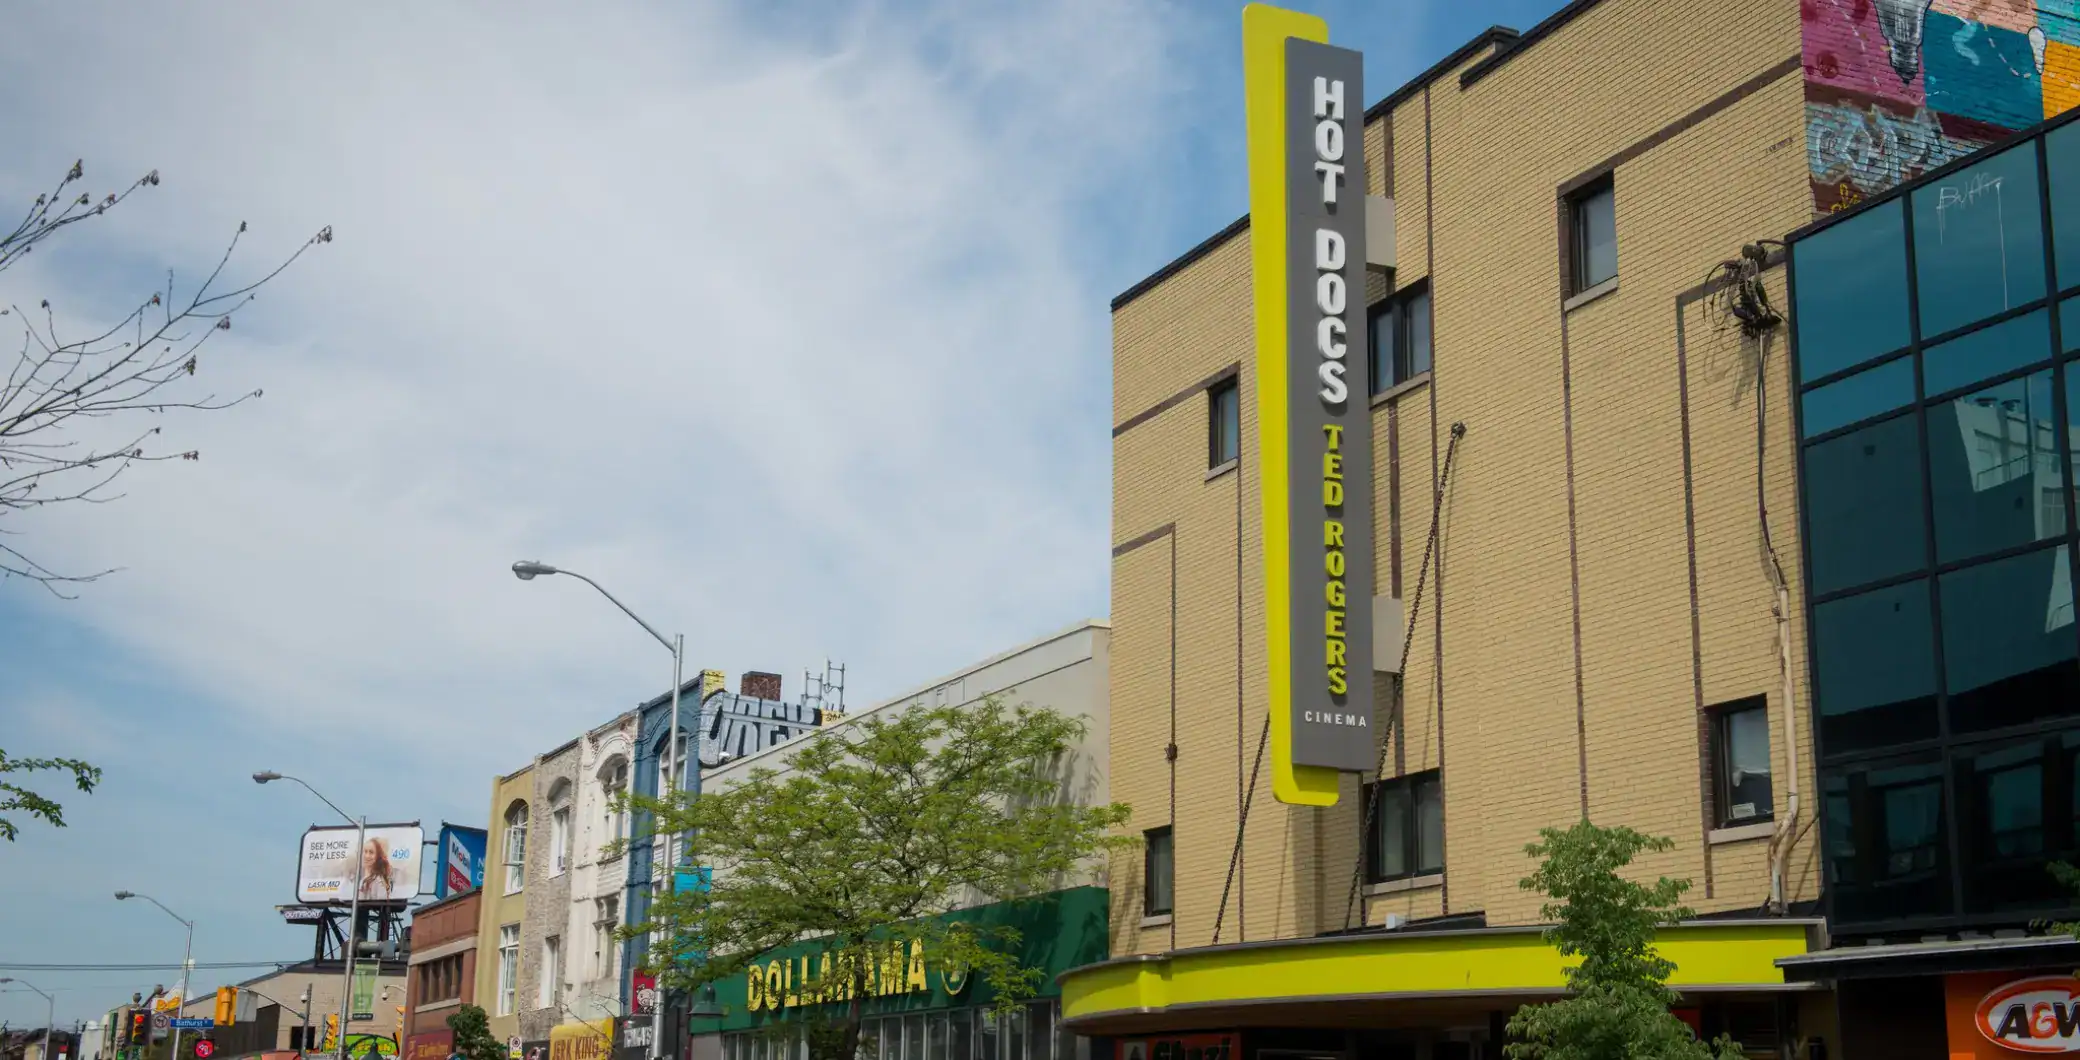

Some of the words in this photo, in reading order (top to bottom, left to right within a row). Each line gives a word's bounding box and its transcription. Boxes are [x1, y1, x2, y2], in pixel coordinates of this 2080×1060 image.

[1314, 76, 1345, 203] HOT
[1316, 228, 1348, 404] DOCS
[1322, 424, 1344, 506] TED
[1323, 520, 1348, 696] ROGERS
[1304, 710, 1367, 728] CINEMA
[309, 852, 325, 860] PAY
[310, 842, 324, 850] SEE
[326, 841, 348, 850] MORE
[175, 1018, 204, 1028] Bathurst
[551, 1038, 574, 1060] JERK
[575, 1035, 599, 1060] KING
